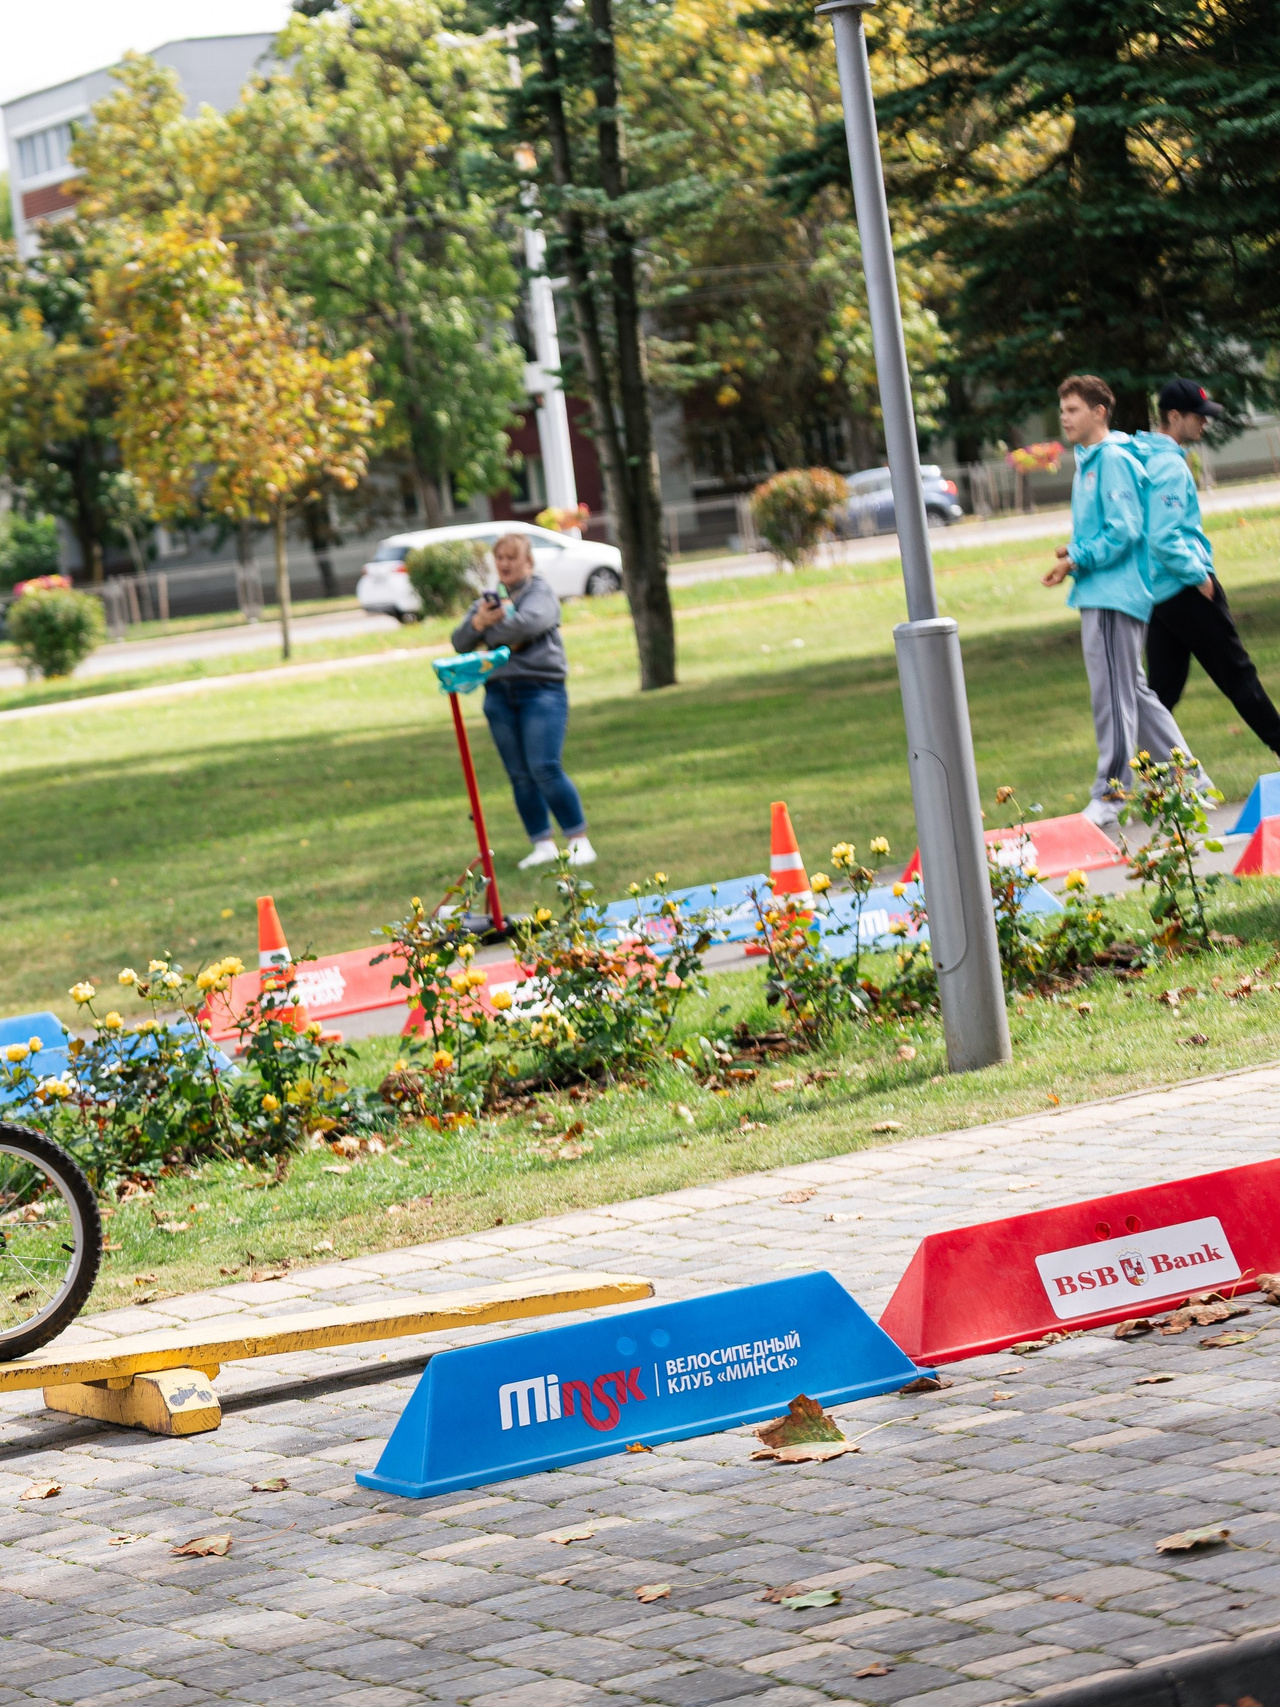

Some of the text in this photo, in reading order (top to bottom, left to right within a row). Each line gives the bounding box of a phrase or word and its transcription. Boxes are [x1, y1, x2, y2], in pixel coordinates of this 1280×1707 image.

[1052, 1243, 1225, 1297] BSB Bank
[664, 1330, 802, 1377] ВЕЛОСИПЕДНЫЙ
[667, 1356, 800, 1395] КЛУБ «МИНСК»
